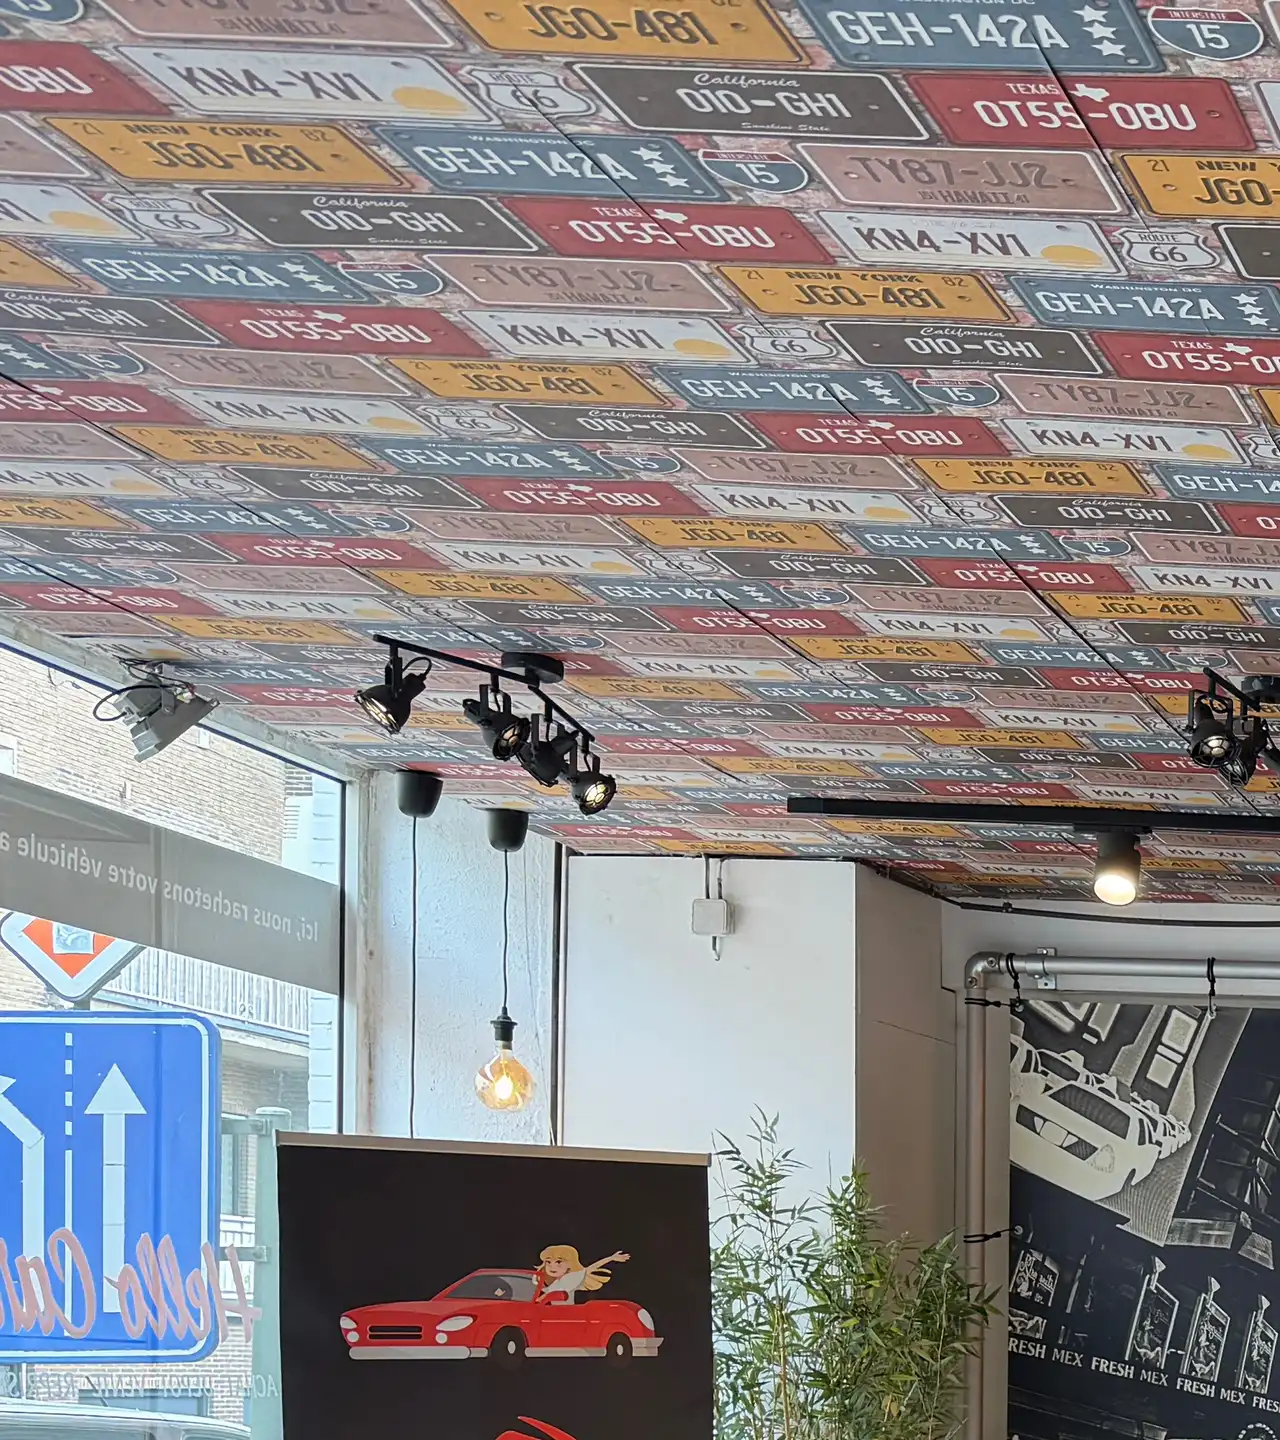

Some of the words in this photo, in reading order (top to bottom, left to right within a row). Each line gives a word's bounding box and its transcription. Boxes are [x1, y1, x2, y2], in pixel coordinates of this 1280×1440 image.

[1166, 8, 1227, 20] INTERSTATE
[528, 6, 720, 46] JGO-481
[835, 9, 1070, 51] GEH-142A
[1185, 23, 1230, 51] 15
[487, 72, 536, 84] ROUTE
[694, 72, 797, 87] California
[1002, 79, 1058, 94] TEXAS
[510, 88, 560, 110] 66
[122, 123, 191, 135] NEW
[196, 125, 282, 138] YORK
[142, 140, 326, 173] JGO-481
[412, 146, 638, 181] GEH-142A
[1194, 160, 1256, 172] NEW
[734, 162, 779, 185] 15
[1149, 245, 1188, 263] 66
[1035, 292, 1226, 320] GEH-142A
[1008, 1336, 1047, 1360] RESH
[1051, 1347, 1085, 1369] MEX
[1090, 1356, 1135, 1380] FRESH
[1139, 1367, 1169, 1387] MEX
[1175, 1377, 1216, 1399] FRESH
[1219, 1386, 1247, 1405] MEX
